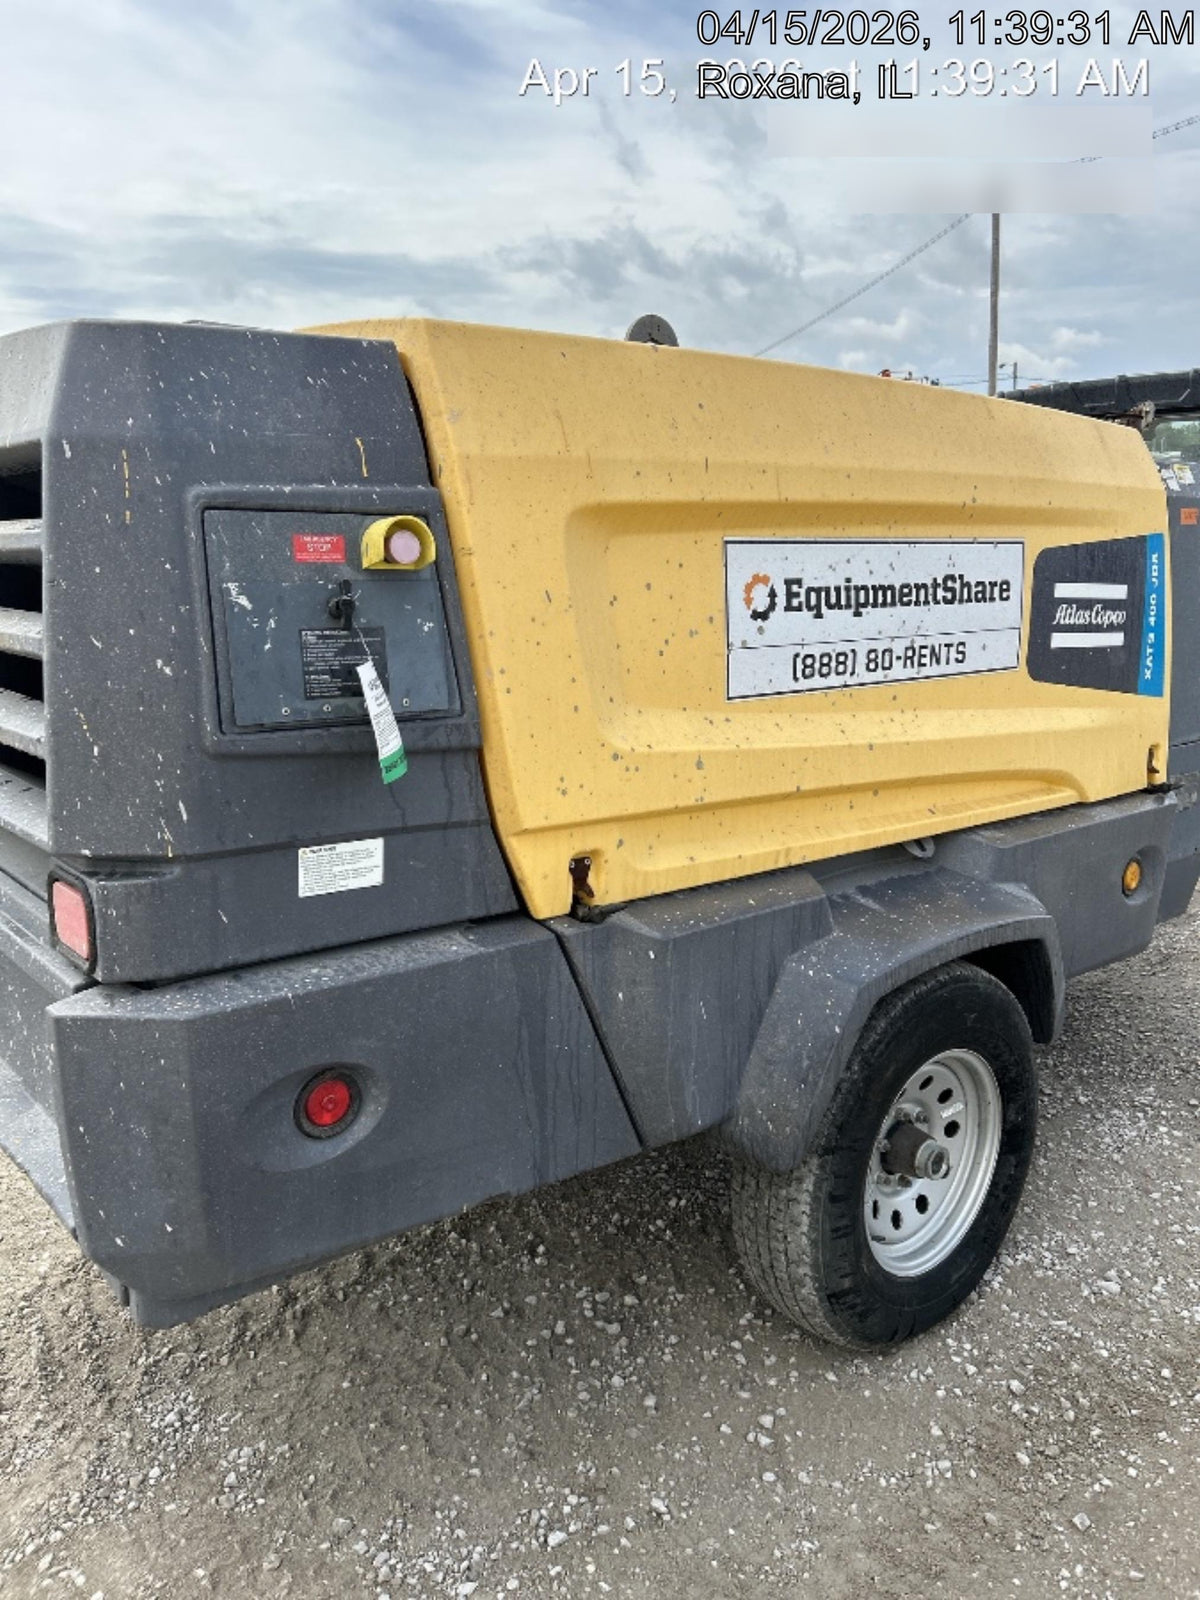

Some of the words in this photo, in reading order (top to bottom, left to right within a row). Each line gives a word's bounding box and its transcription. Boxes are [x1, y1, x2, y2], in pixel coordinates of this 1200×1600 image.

[783, 574, 1011, 619] EquipmentShare
[1052, 603, 1091, 625] Atlas
[1148, 593, 1158, 628] 400
[792, 649, 857, 683] (888)
[865, 641, 967, 673] 80-RENTS
